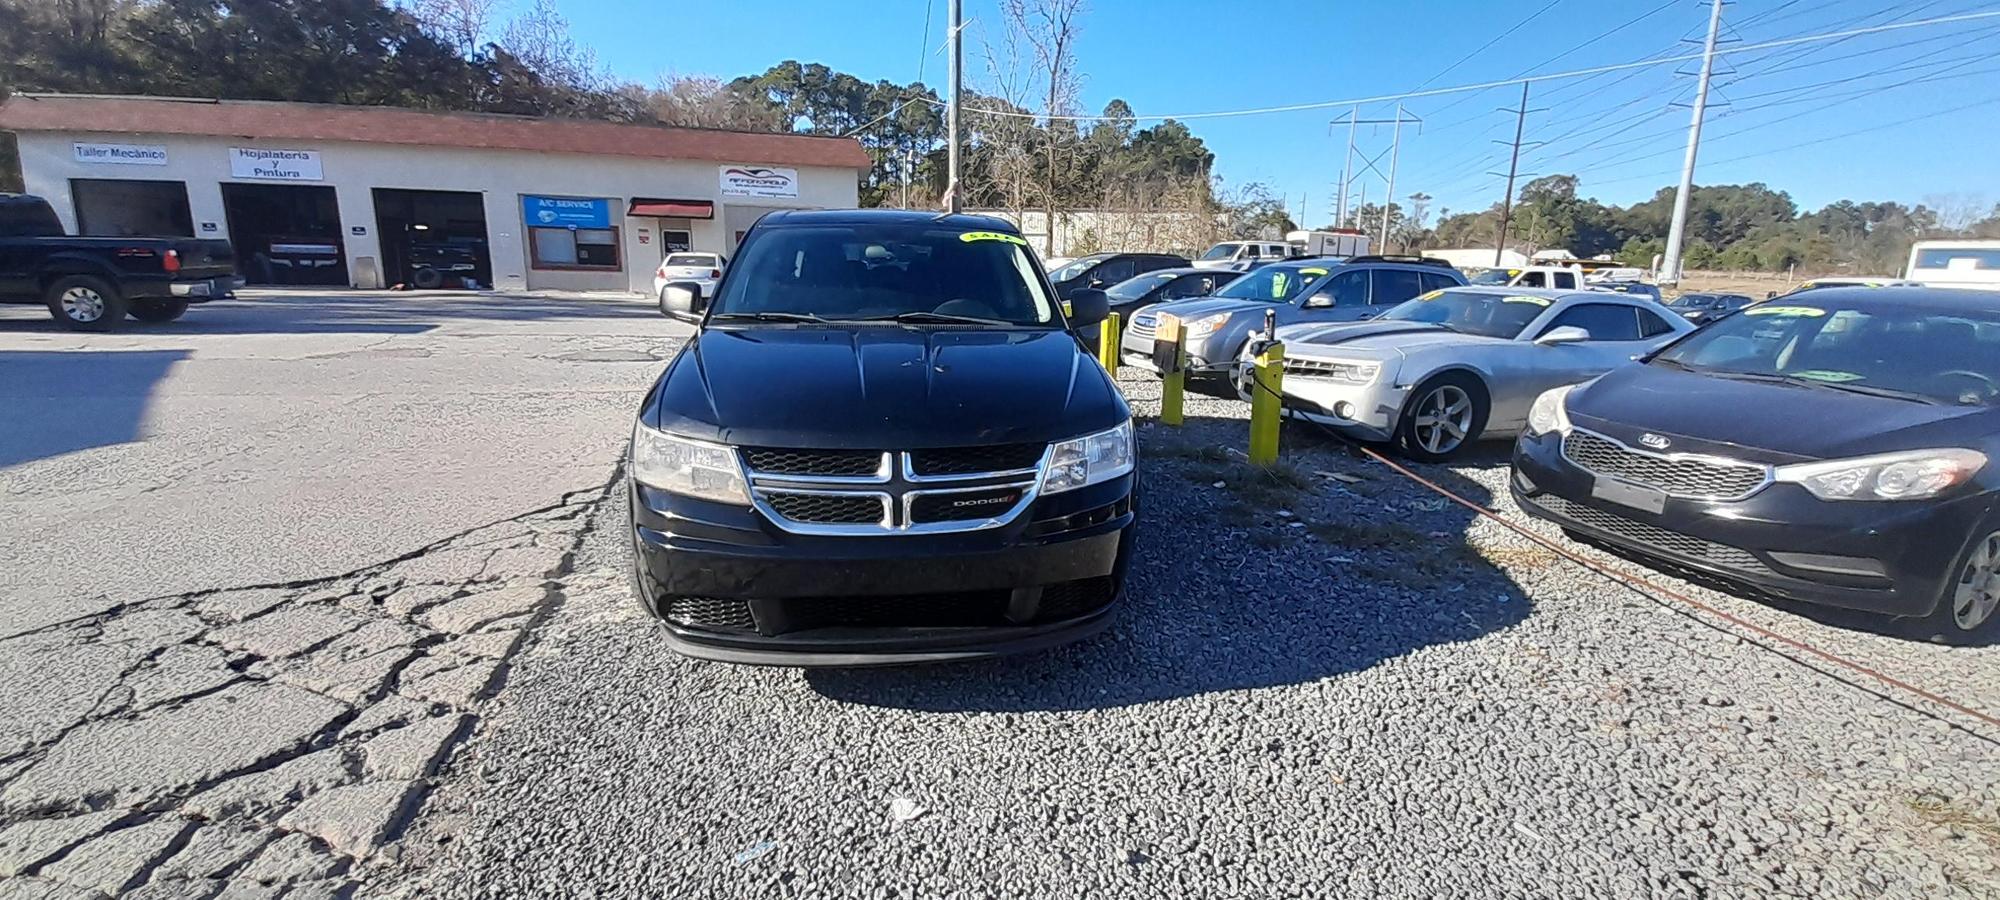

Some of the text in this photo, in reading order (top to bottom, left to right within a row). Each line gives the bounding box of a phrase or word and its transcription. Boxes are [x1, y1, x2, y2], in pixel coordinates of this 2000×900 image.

[76, 146, 107, 157] Taller
[272, 160, 280, 169] y
[254, 168, 300, 177] Pintura
[953, 497, 1008, 507] DODGE
